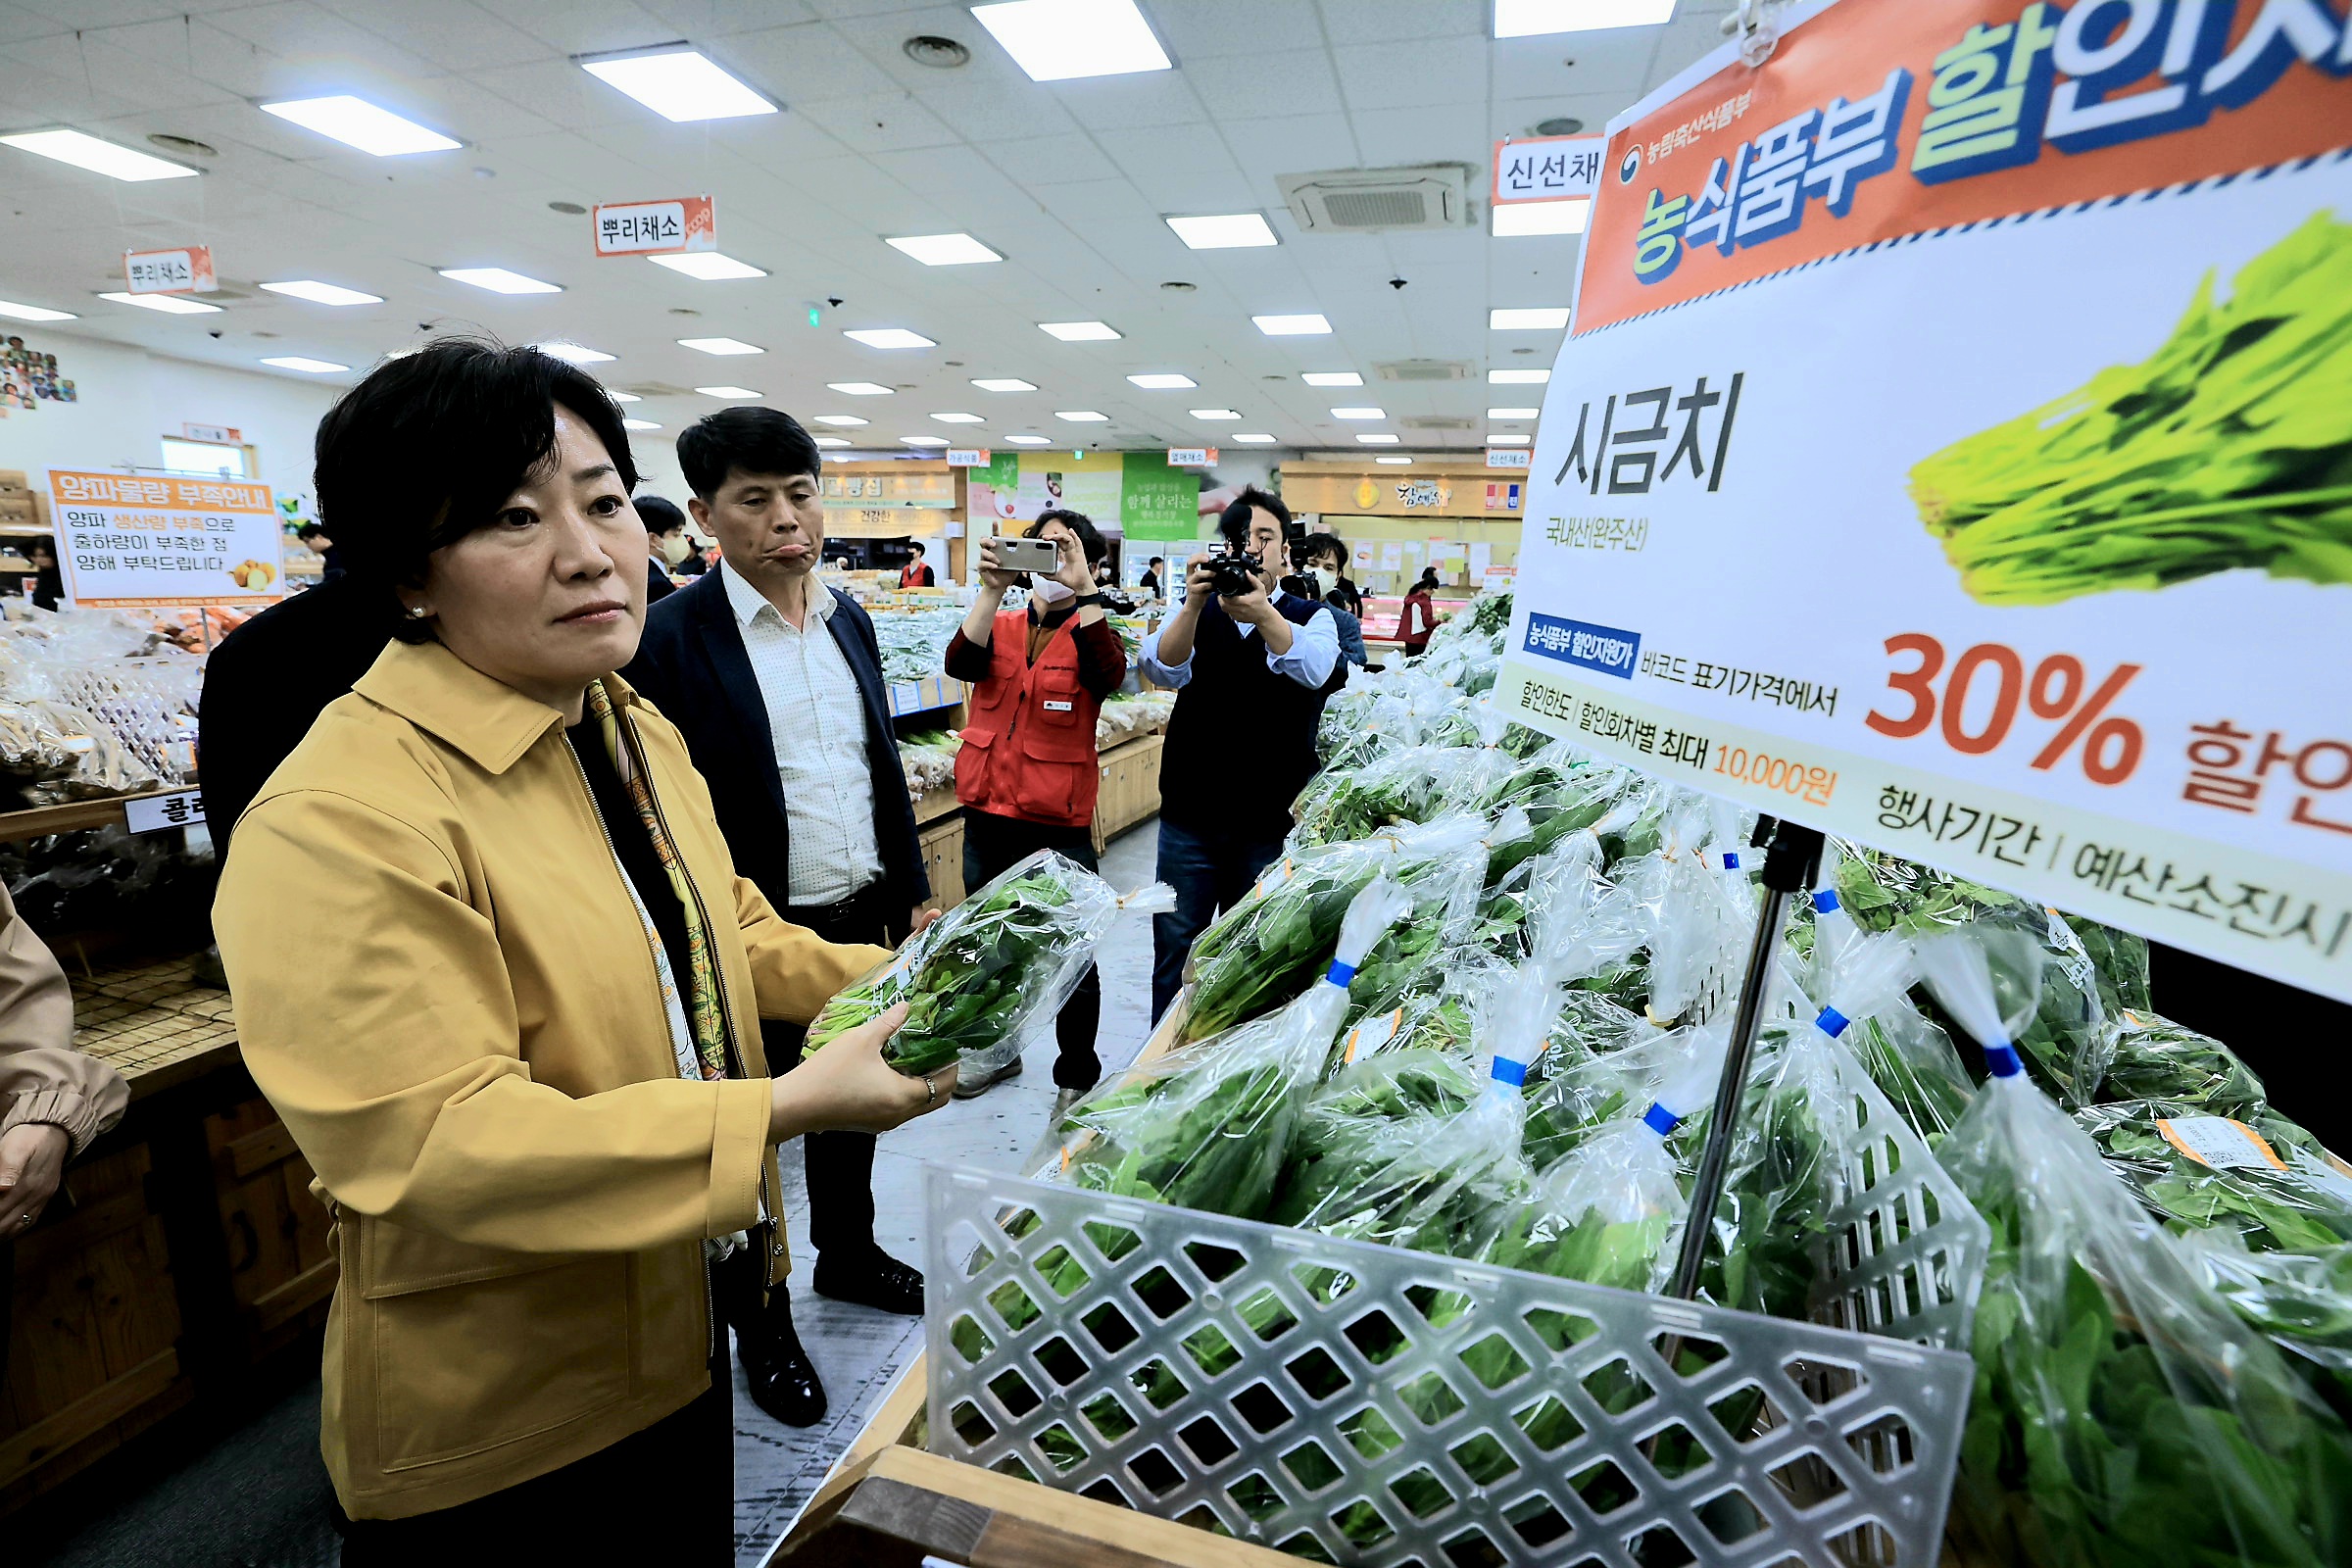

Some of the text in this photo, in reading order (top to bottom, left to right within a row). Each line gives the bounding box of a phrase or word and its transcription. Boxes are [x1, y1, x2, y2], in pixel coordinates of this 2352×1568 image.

[1646, 89, 1753, 165] 농림축산식품부
[1633, 68, 1911, 282] 농식품부
[603, 215, 679, 244] 뿌리채소
[131, 261, 188, 285] 뿌리채소
[1554, 371, 1745, 495] 시금치
[949, 453, 977, 464] 가공식품
[1171, 453, 1203, 463] 열매채소
[1490, 454, 1526, 465] 신선채소
[59, 475, 268, 510] 양파물량 부족안내
[1154, 494, 1193, 510] 살리는
[67, 511, 236, 533] 양파 생산량 부족으로
[860, 510, 891, 523] 건강한
[74, 533, 228, 552] 출하량이 부족한 점
[1546, 516, 1648, 552] 국내산(완주산)
[75, 555, 223, 572] 양해 부탁드립니다
[1530, 621, 1838, 717] 농식품부 할인지원가 바코드 표기가격에서
[1864, 632, 2144, 786] 30%
[1520, 679, 2351, 958] 할인한도 할인회차별 최대 10,000원 행사기간 예산소진시
